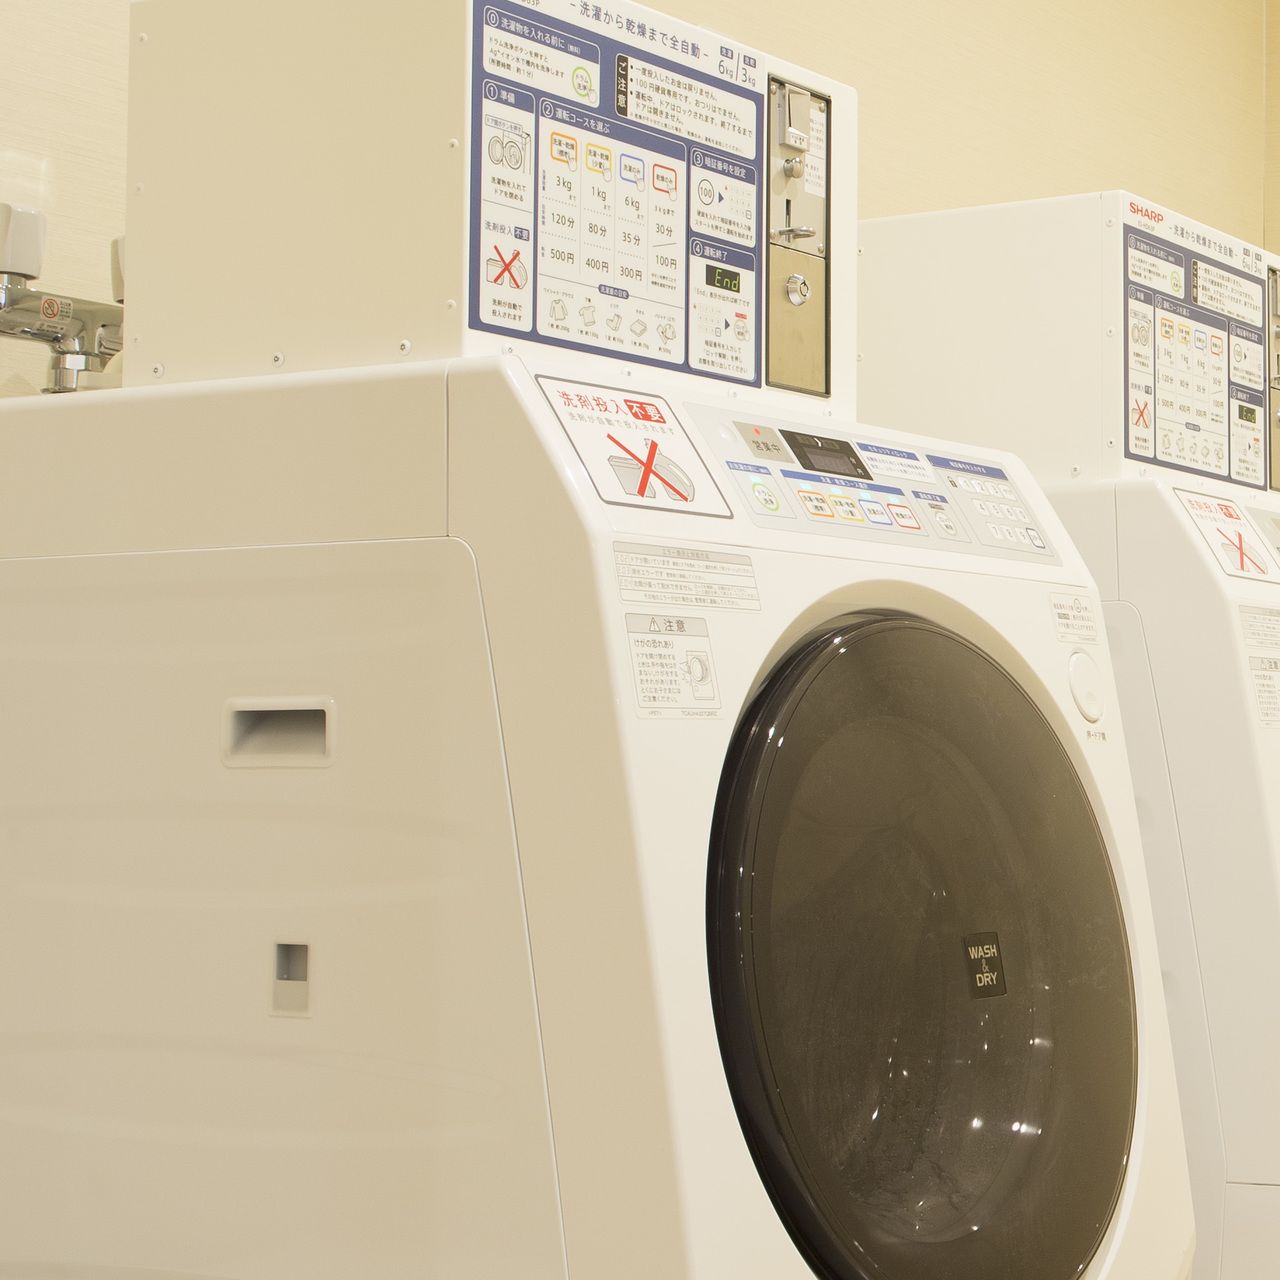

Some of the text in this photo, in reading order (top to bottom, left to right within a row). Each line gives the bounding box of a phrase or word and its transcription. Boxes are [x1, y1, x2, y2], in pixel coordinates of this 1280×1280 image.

[501, 17, 565, 49] 洗濯物を入れる前に
[556, 107, 611, 133] 運転コースを選ぶ
[1129, 201, 1164, 224] SHARP
[551, 212, 575, 229] 120分
[588, 223, 607, 237] 80分
[655, 223, 673, 237] 30分
[622, 232, 640, 246] 35分
[550, 249, 575, 265] 500円
[655, 255, 677, 270] 100円
[585, 258, 609, 273] 400円
[620, 266, 642, 281] 300円
[715, 269, 739, 291] End
[557, 390, 662, 421] 洗剤投入 不要
[664, 619, 686, 632] 注意
[634, 639, 674, 649] けがの恐れあり
[968, 944, 998, 959] WASH
[982, 959, 989, 972] &
[976, 972, 997, 987] DRY
